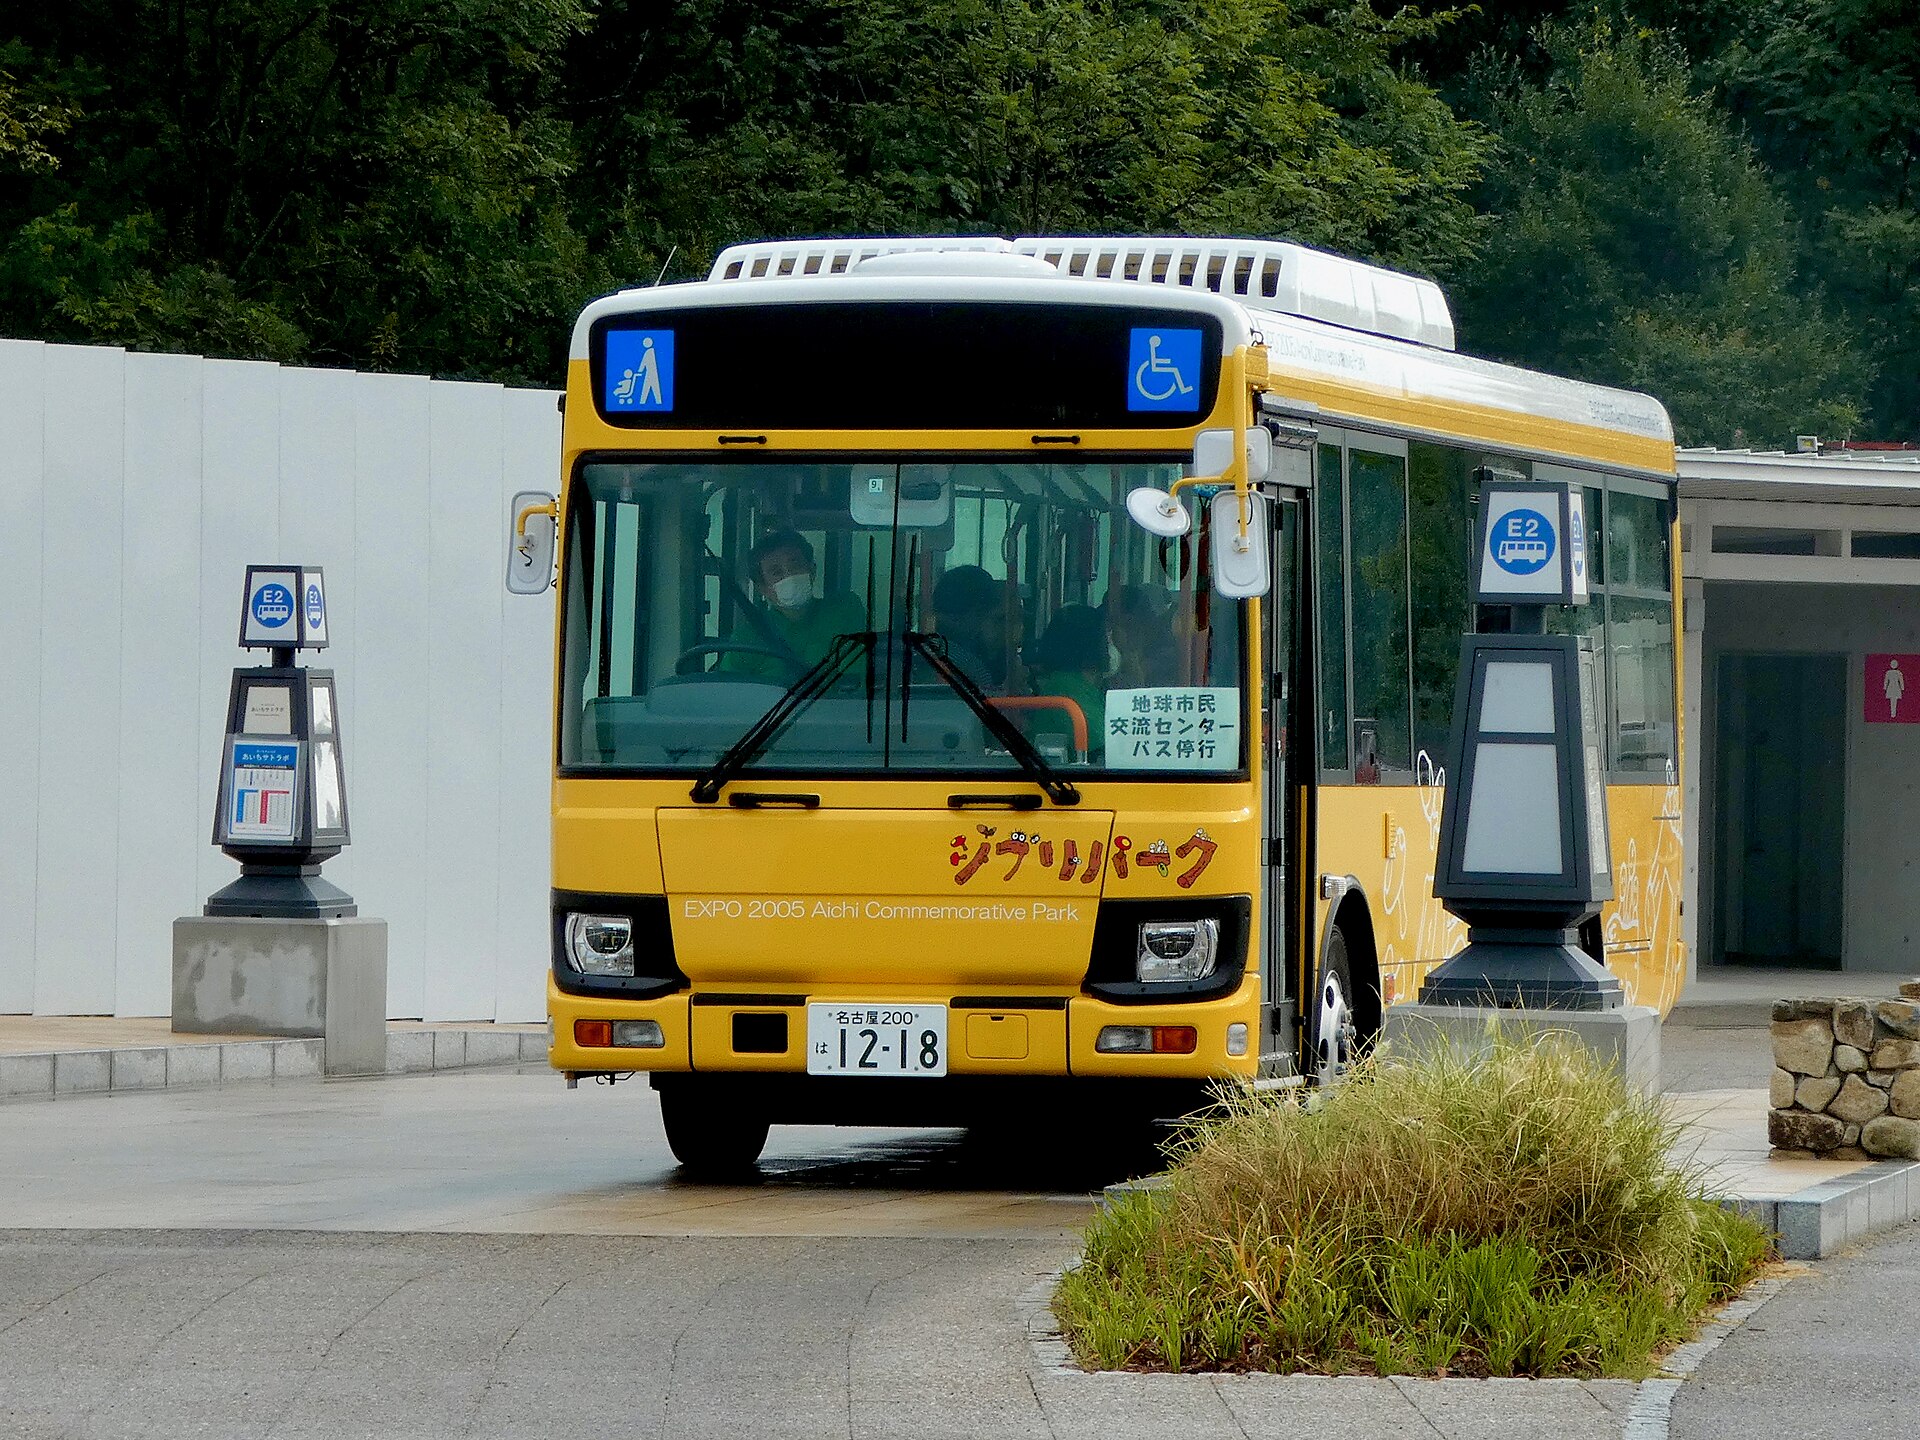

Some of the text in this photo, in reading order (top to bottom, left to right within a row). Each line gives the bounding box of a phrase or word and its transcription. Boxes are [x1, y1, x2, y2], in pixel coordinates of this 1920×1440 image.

[1507, 518, 1539, 537] E2
[263, 590, 283, 603] E2
[309, 590, 318, 604] E2
[1131, 694, 1216, 713] 地球市民
[1109, 717, 1235, 735] 交流センター
[242, 753, 290, 762] あいちサトラボ
[1132, 739, 1216, 759] バス停行
[949, 824, 1218, 889] ジブリパーク
[684, 900, 1079, 921] EXPO 2005 Aichi Commemorative Park
[815, 1028, 939, 1069] は 12-18
